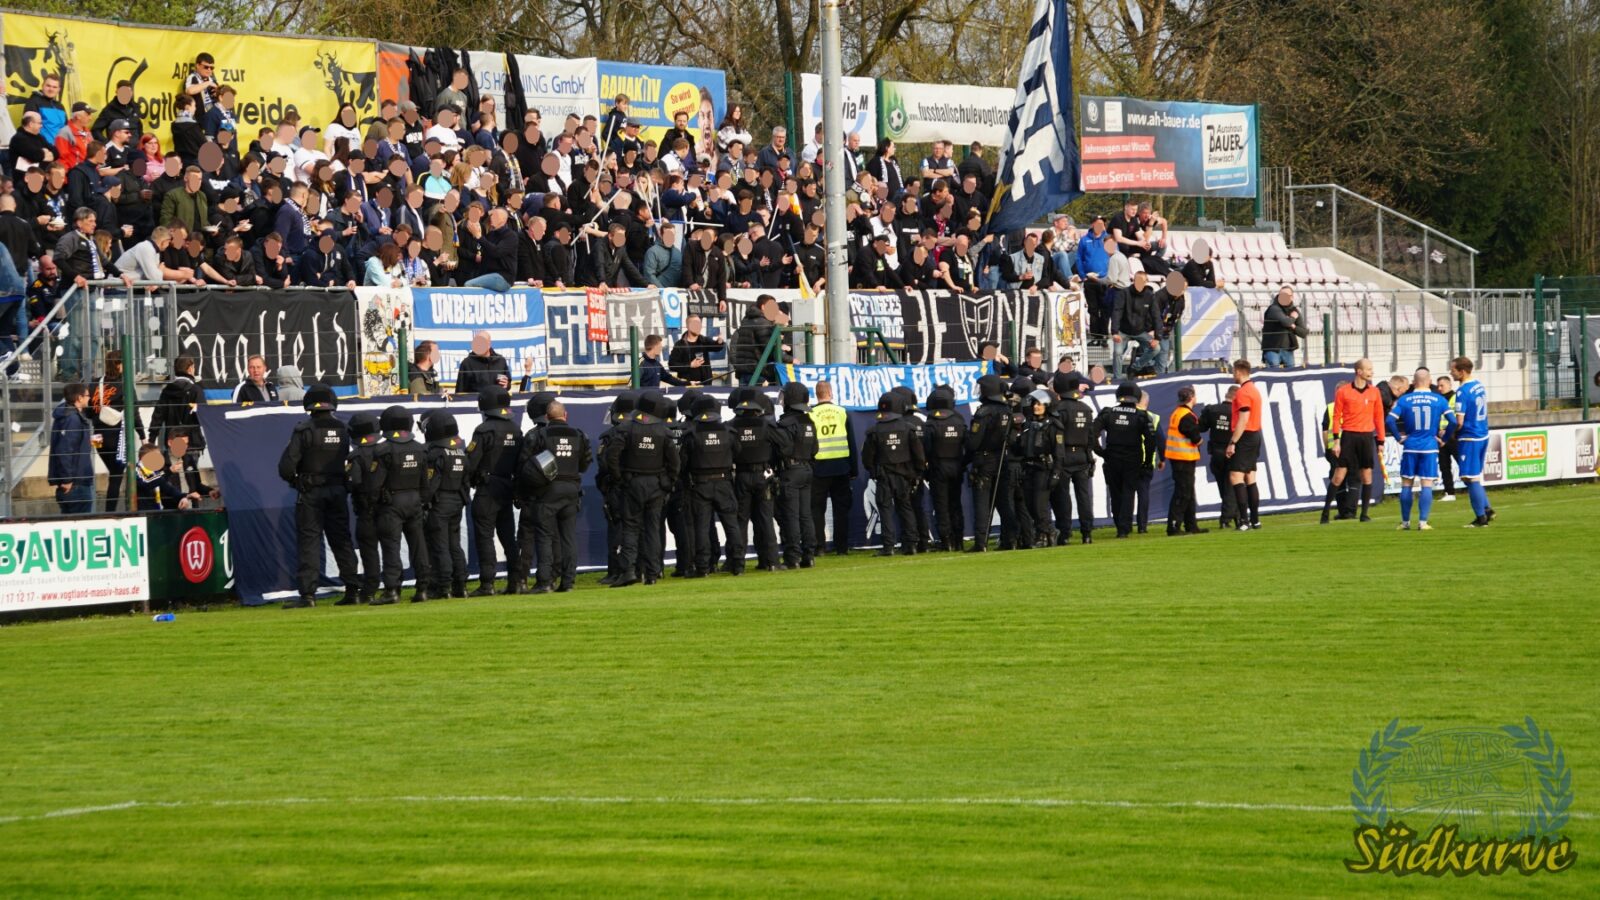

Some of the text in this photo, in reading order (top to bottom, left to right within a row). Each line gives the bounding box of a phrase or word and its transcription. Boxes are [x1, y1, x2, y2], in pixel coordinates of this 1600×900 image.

[221, 68, 246, 83] zur
[552, 75, 586, 95] GmbH
[1127, 111, 1200, 129] www.ah-bauer.de
[1206, 125, 1243, 153] BAUER
[430, 293, 528, 325] UNBEUGSAM
[177, 310, 348, 384] Saalfeld
[799, 365, 982, 406] SÜDKURVE BLEIBT
[1112, 406, 1136, 414] POLIZEI
[1412, 406, 1432, 430] 11
[821, 424, 837, 436] 07
[1508, 438, 1544, 457] SEIDEL
[1509, 463, 1545, 475] WOHNWELT
[7, 593, 15, 604] 17
[17, 592, 25, 603] 12
[27, 592, 35, 602] 17
[41, 586, 140, 601] www.vogtland-massiv-haus.de
